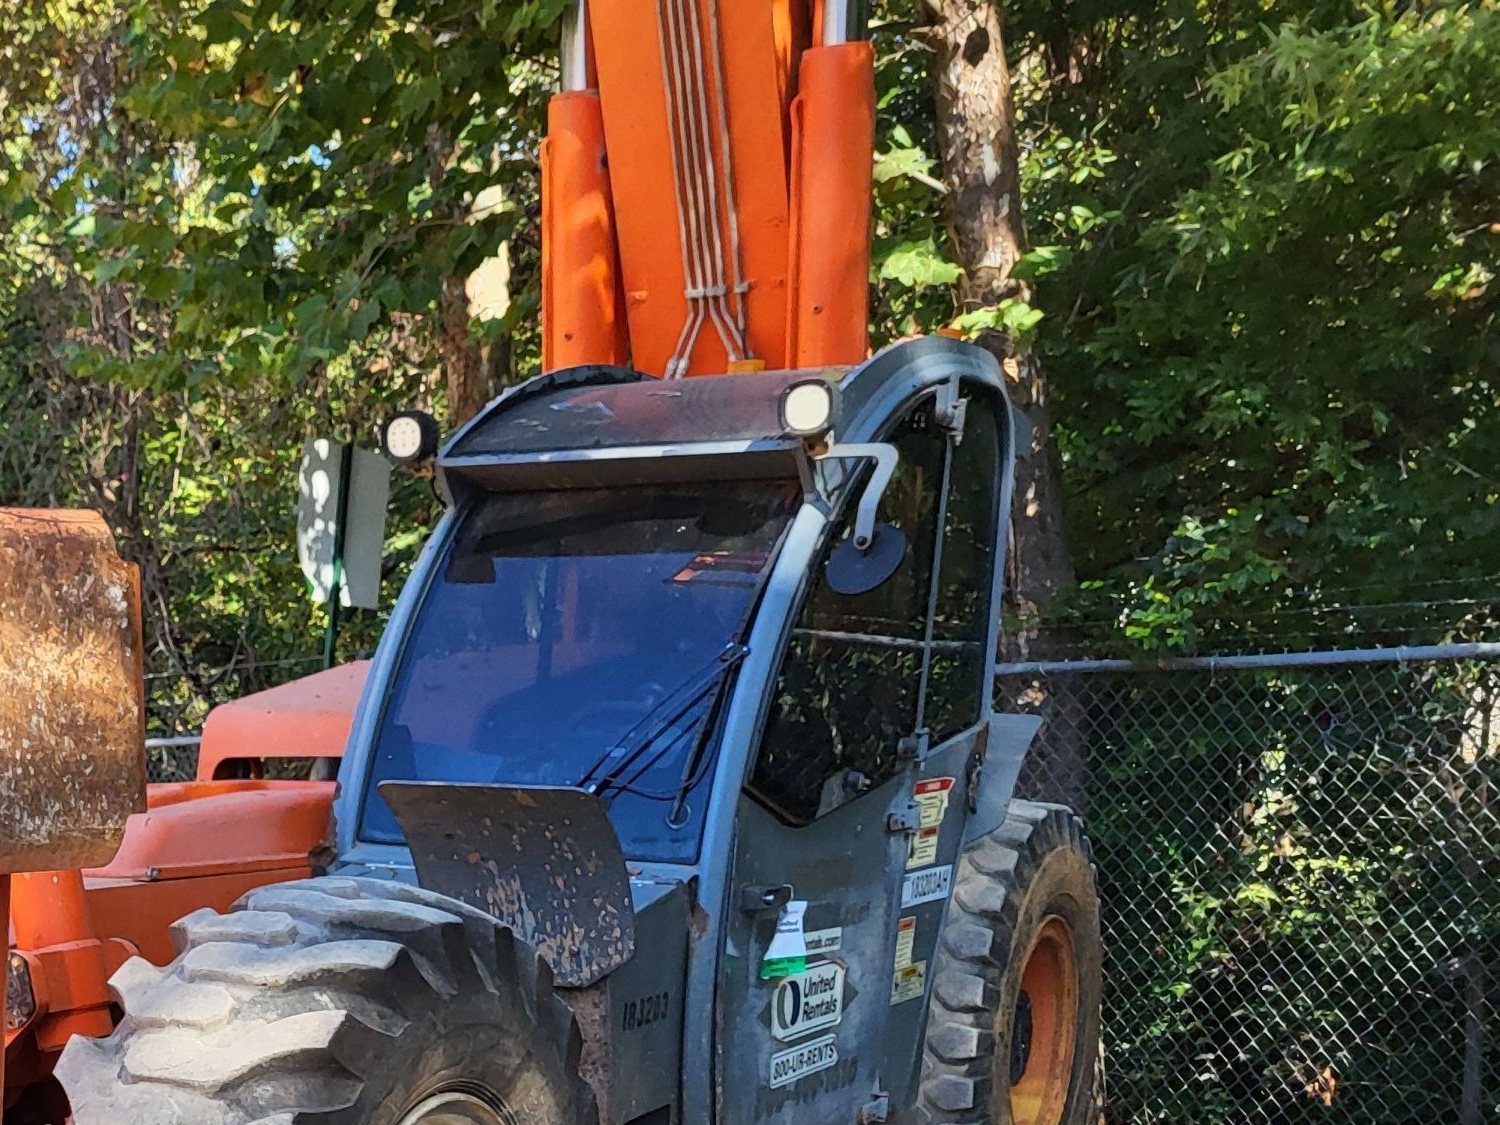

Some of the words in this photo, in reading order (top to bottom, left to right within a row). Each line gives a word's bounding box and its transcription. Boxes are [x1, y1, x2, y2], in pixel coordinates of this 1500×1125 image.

[803, 970, 838, 998] United
[622, 991, 669, 1031] 183203
[802, 994, 838, 1022] Rentals
[773, 1043, 835, 1081] 800-UR-RENTS
